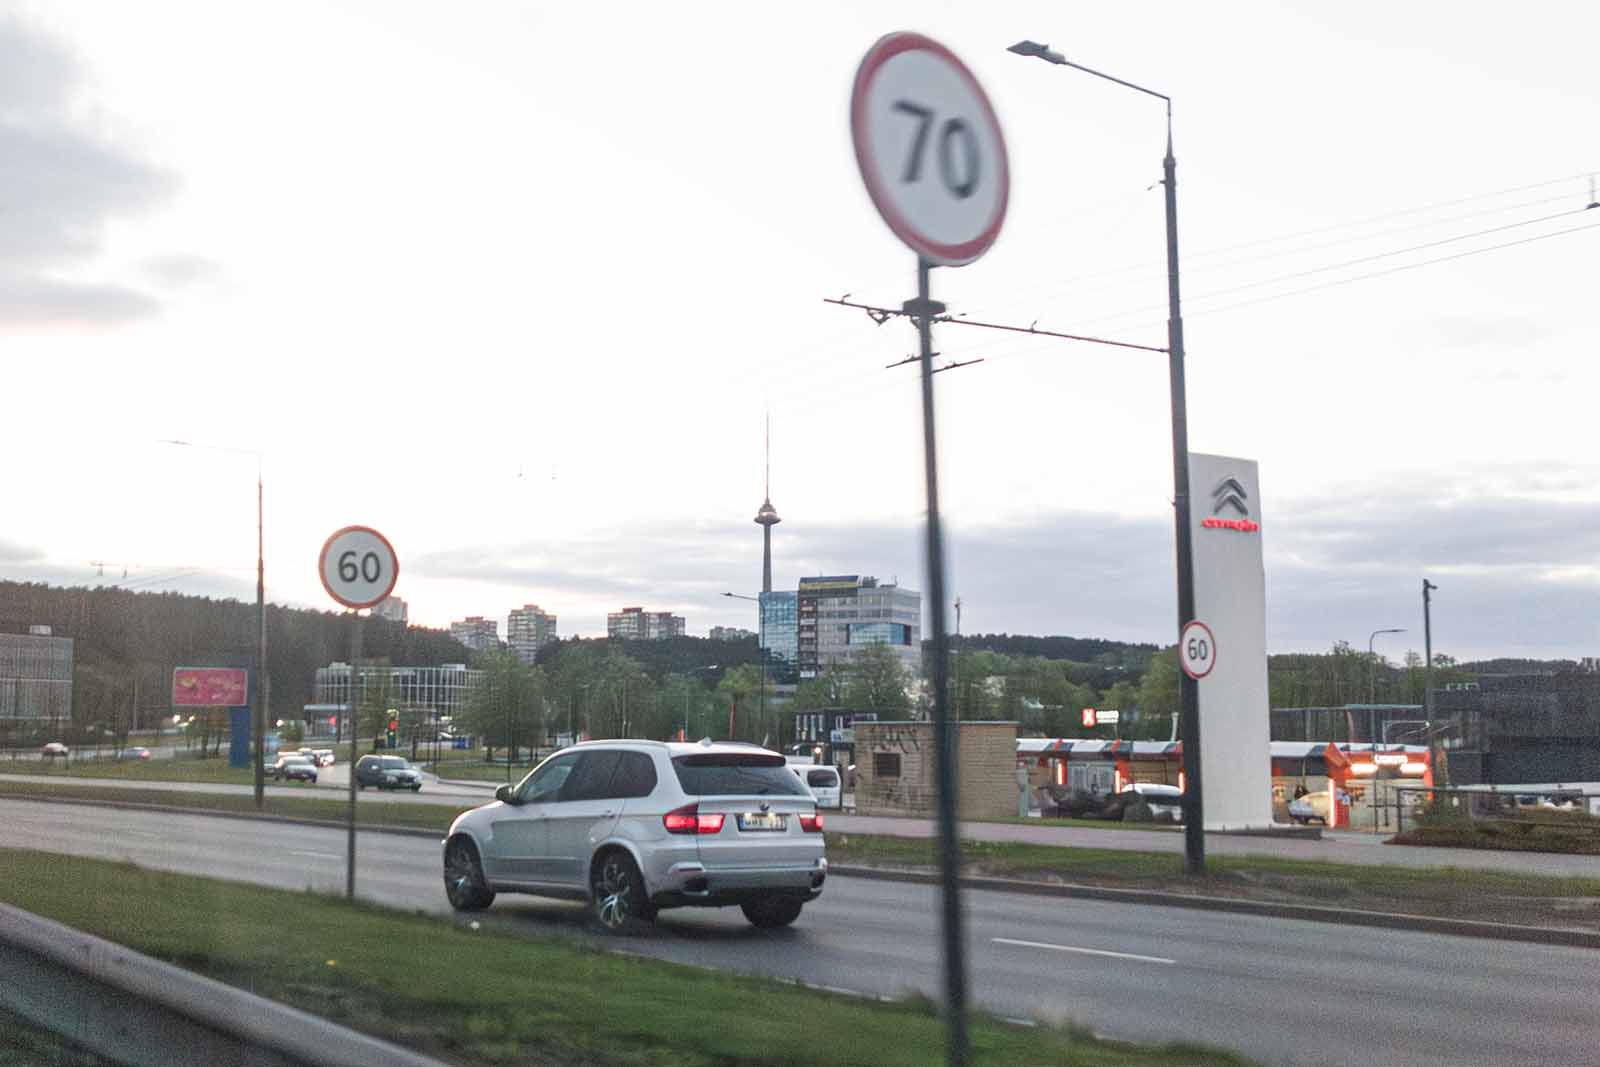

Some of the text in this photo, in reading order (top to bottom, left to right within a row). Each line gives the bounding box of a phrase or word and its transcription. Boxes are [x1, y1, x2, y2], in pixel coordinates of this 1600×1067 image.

[890, 100, 981, 199] 70
[338, 550, 381, 584] 60
[1188, 638, 1208, 661] 60
